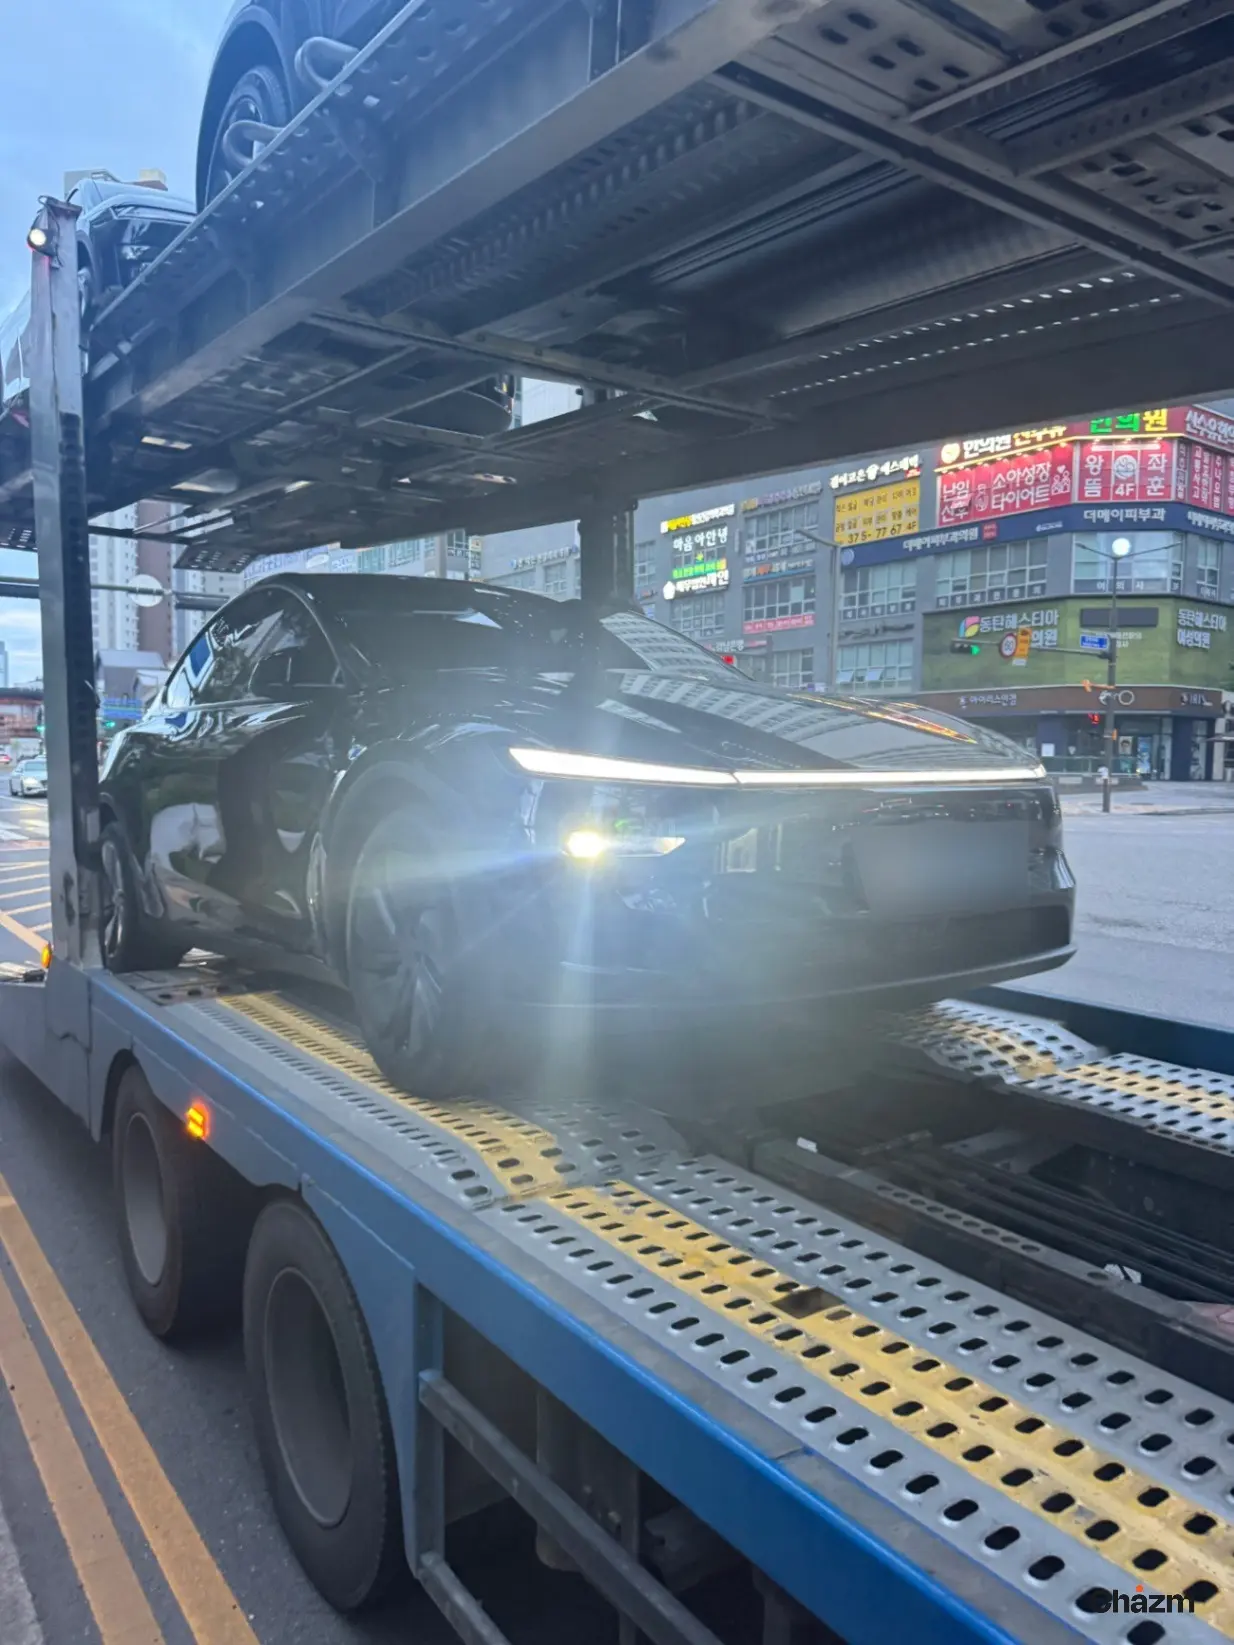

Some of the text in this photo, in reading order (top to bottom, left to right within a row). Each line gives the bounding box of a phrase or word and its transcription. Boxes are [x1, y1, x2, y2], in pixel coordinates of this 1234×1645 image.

[993, 461, 1052, 489] 소아성장
[943, 479, 970, 502] 난임
[1115, 483, 1135, 497] 4F
